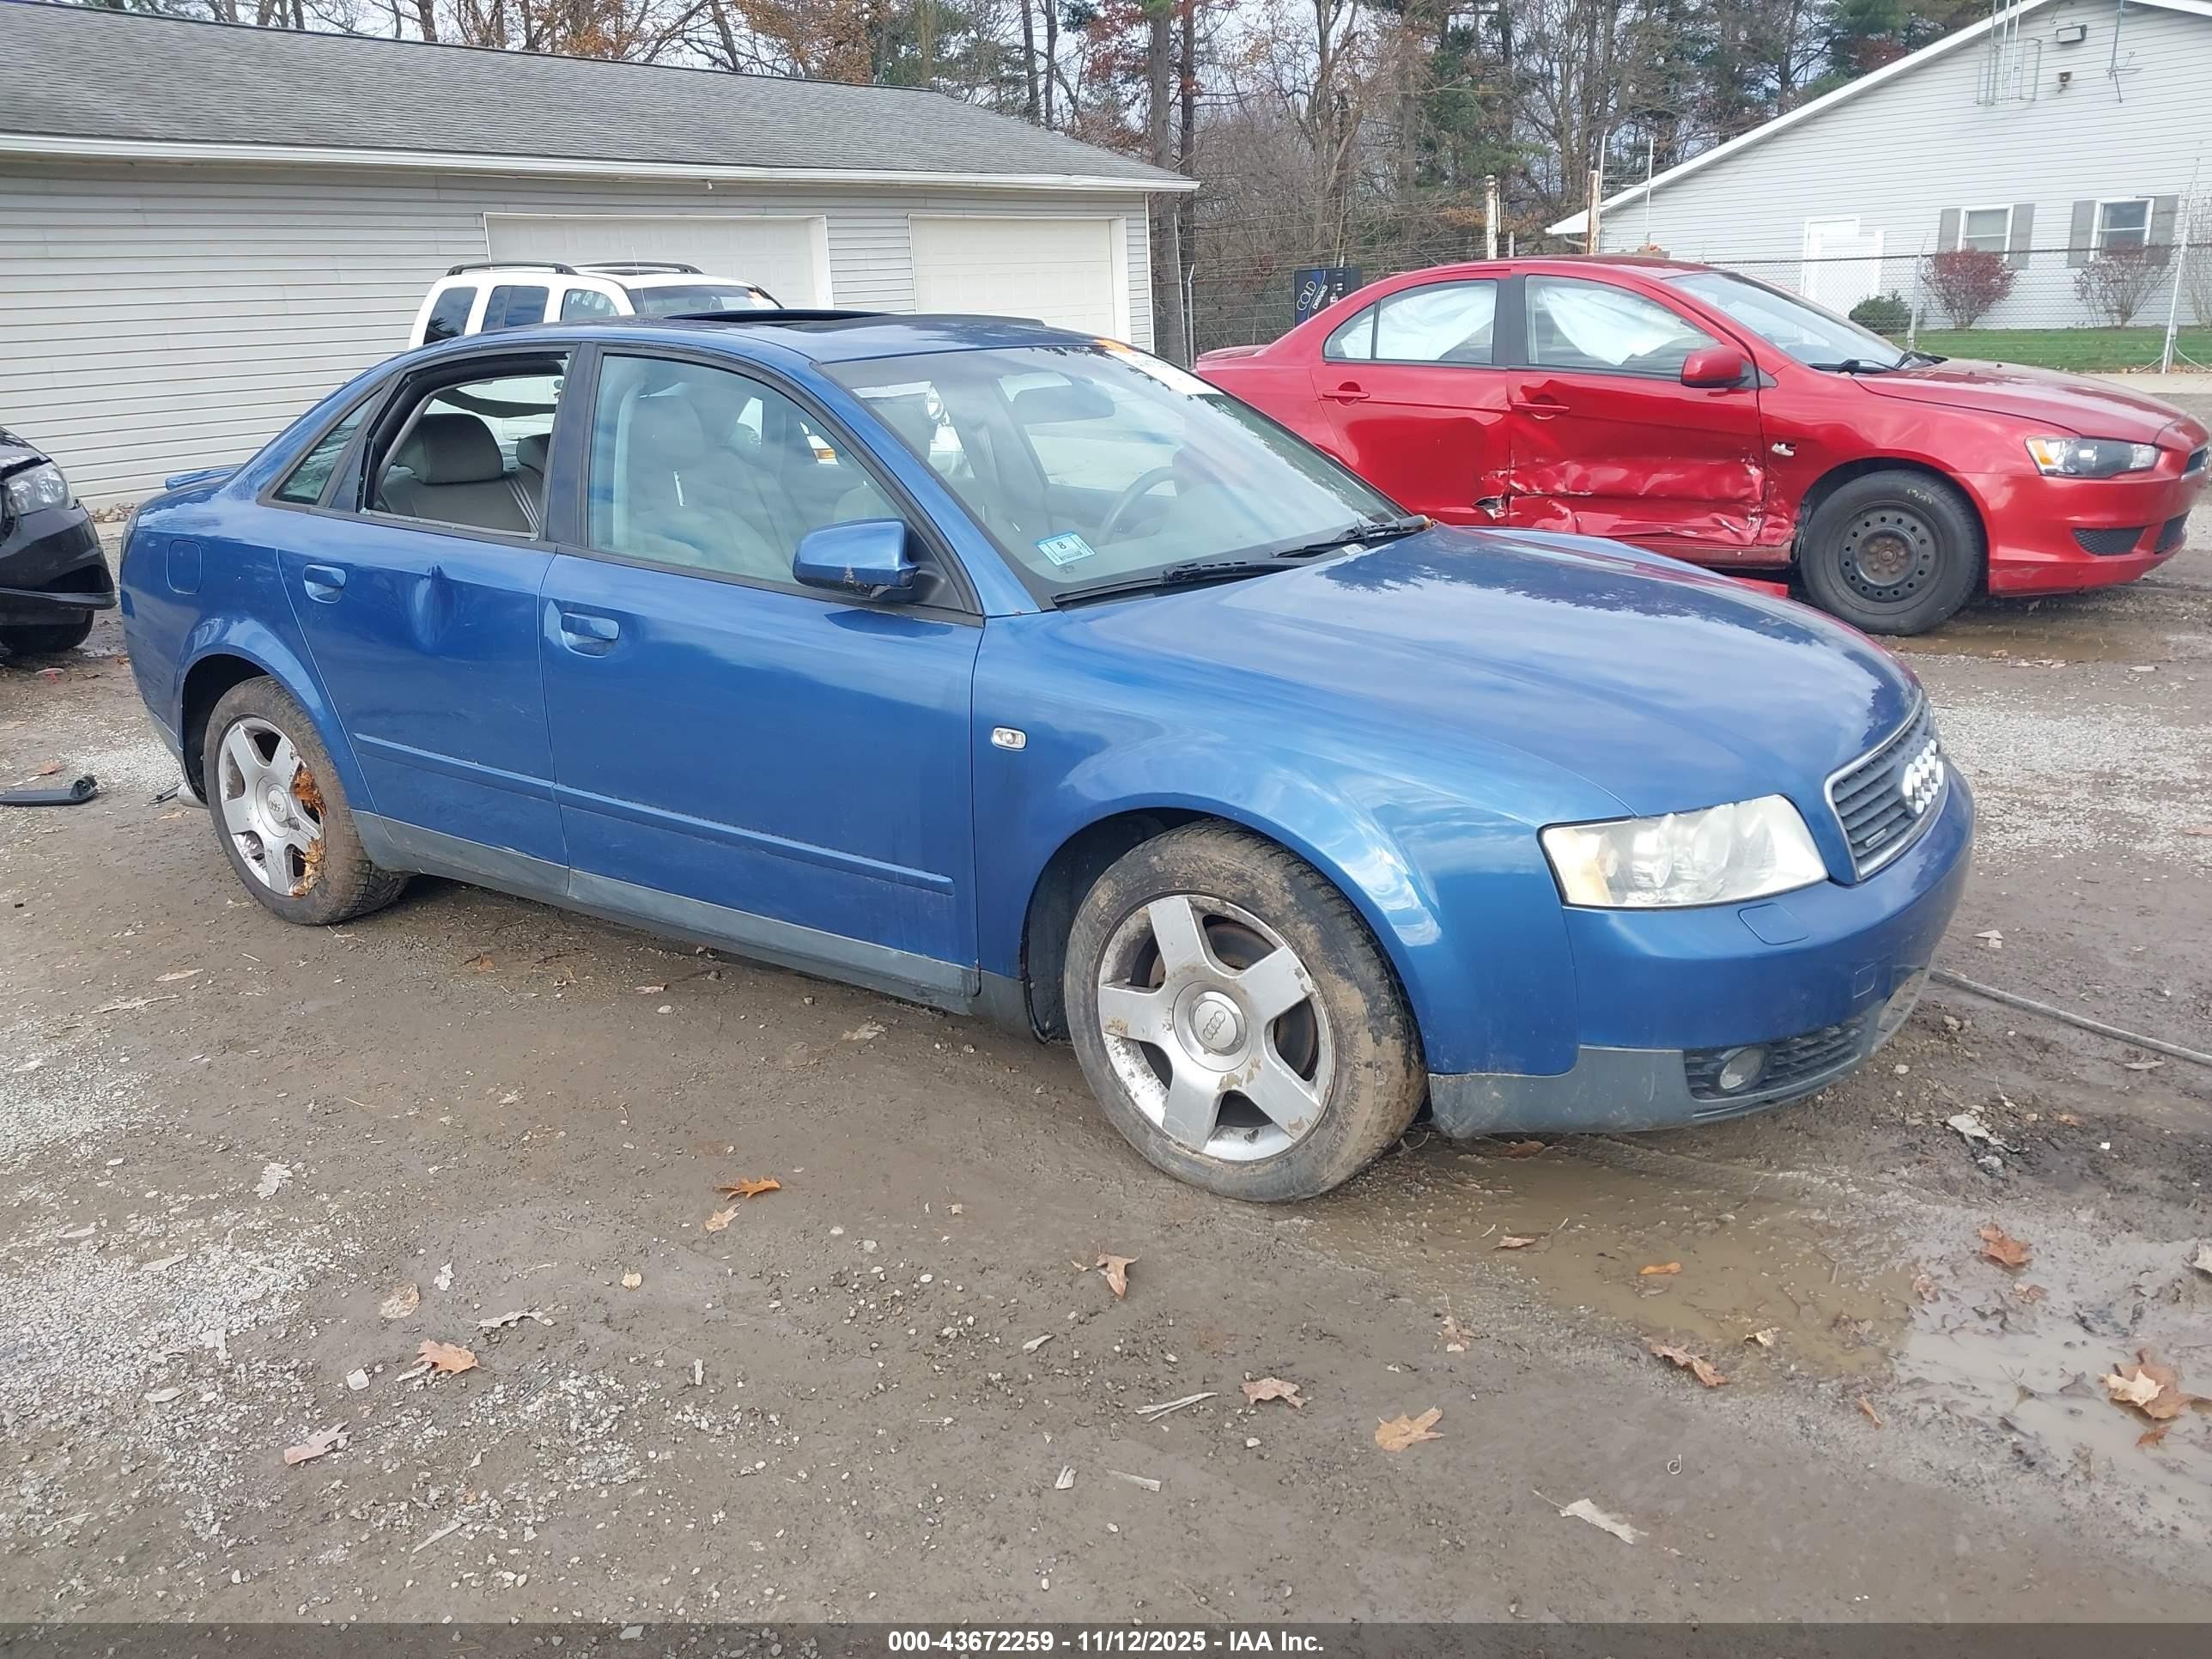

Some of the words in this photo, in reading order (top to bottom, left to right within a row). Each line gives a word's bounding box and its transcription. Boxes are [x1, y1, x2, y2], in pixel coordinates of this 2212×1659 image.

[1297, 281, 1316, 311] COLD
[1312, 283, 1328, 310] DRINKS
[1056, 541, 1066, 550] 8
